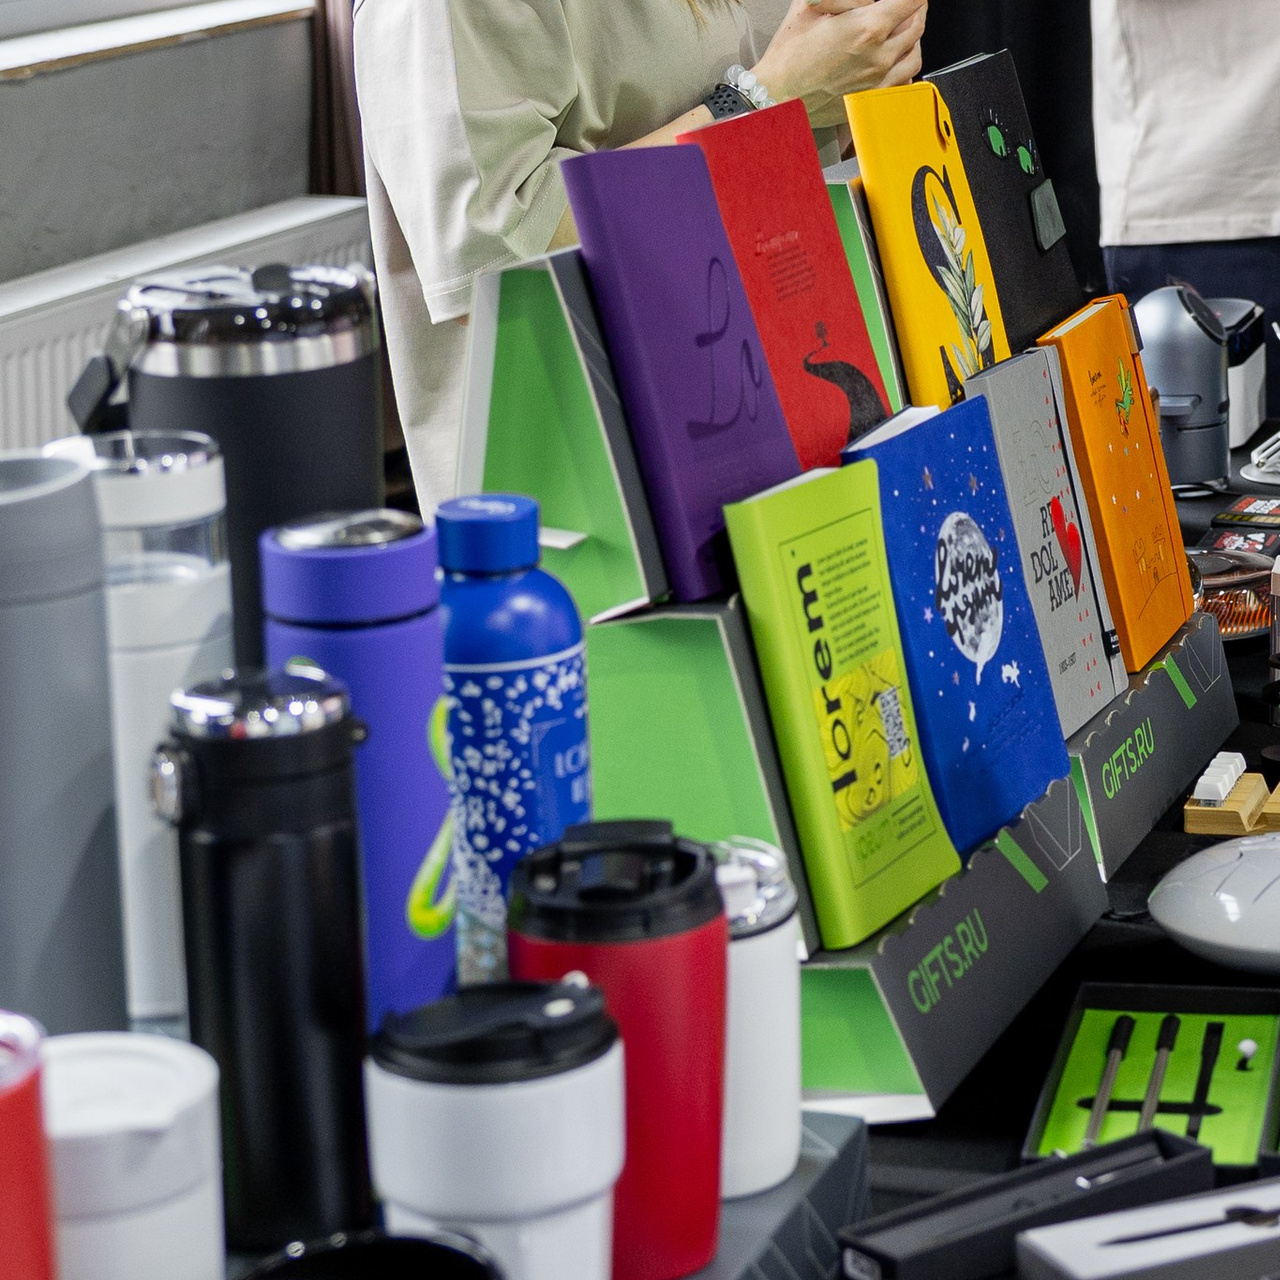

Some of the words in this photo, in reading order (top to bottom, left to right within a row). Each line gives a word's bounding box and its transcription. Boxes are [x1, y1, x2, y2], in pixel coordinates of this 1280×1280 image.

[796, 561, 859, 797] lorem
[1101, 716, 1155, 800] GIFTS.RU
[907, 907, 989, 1014] GIFTS.RU
